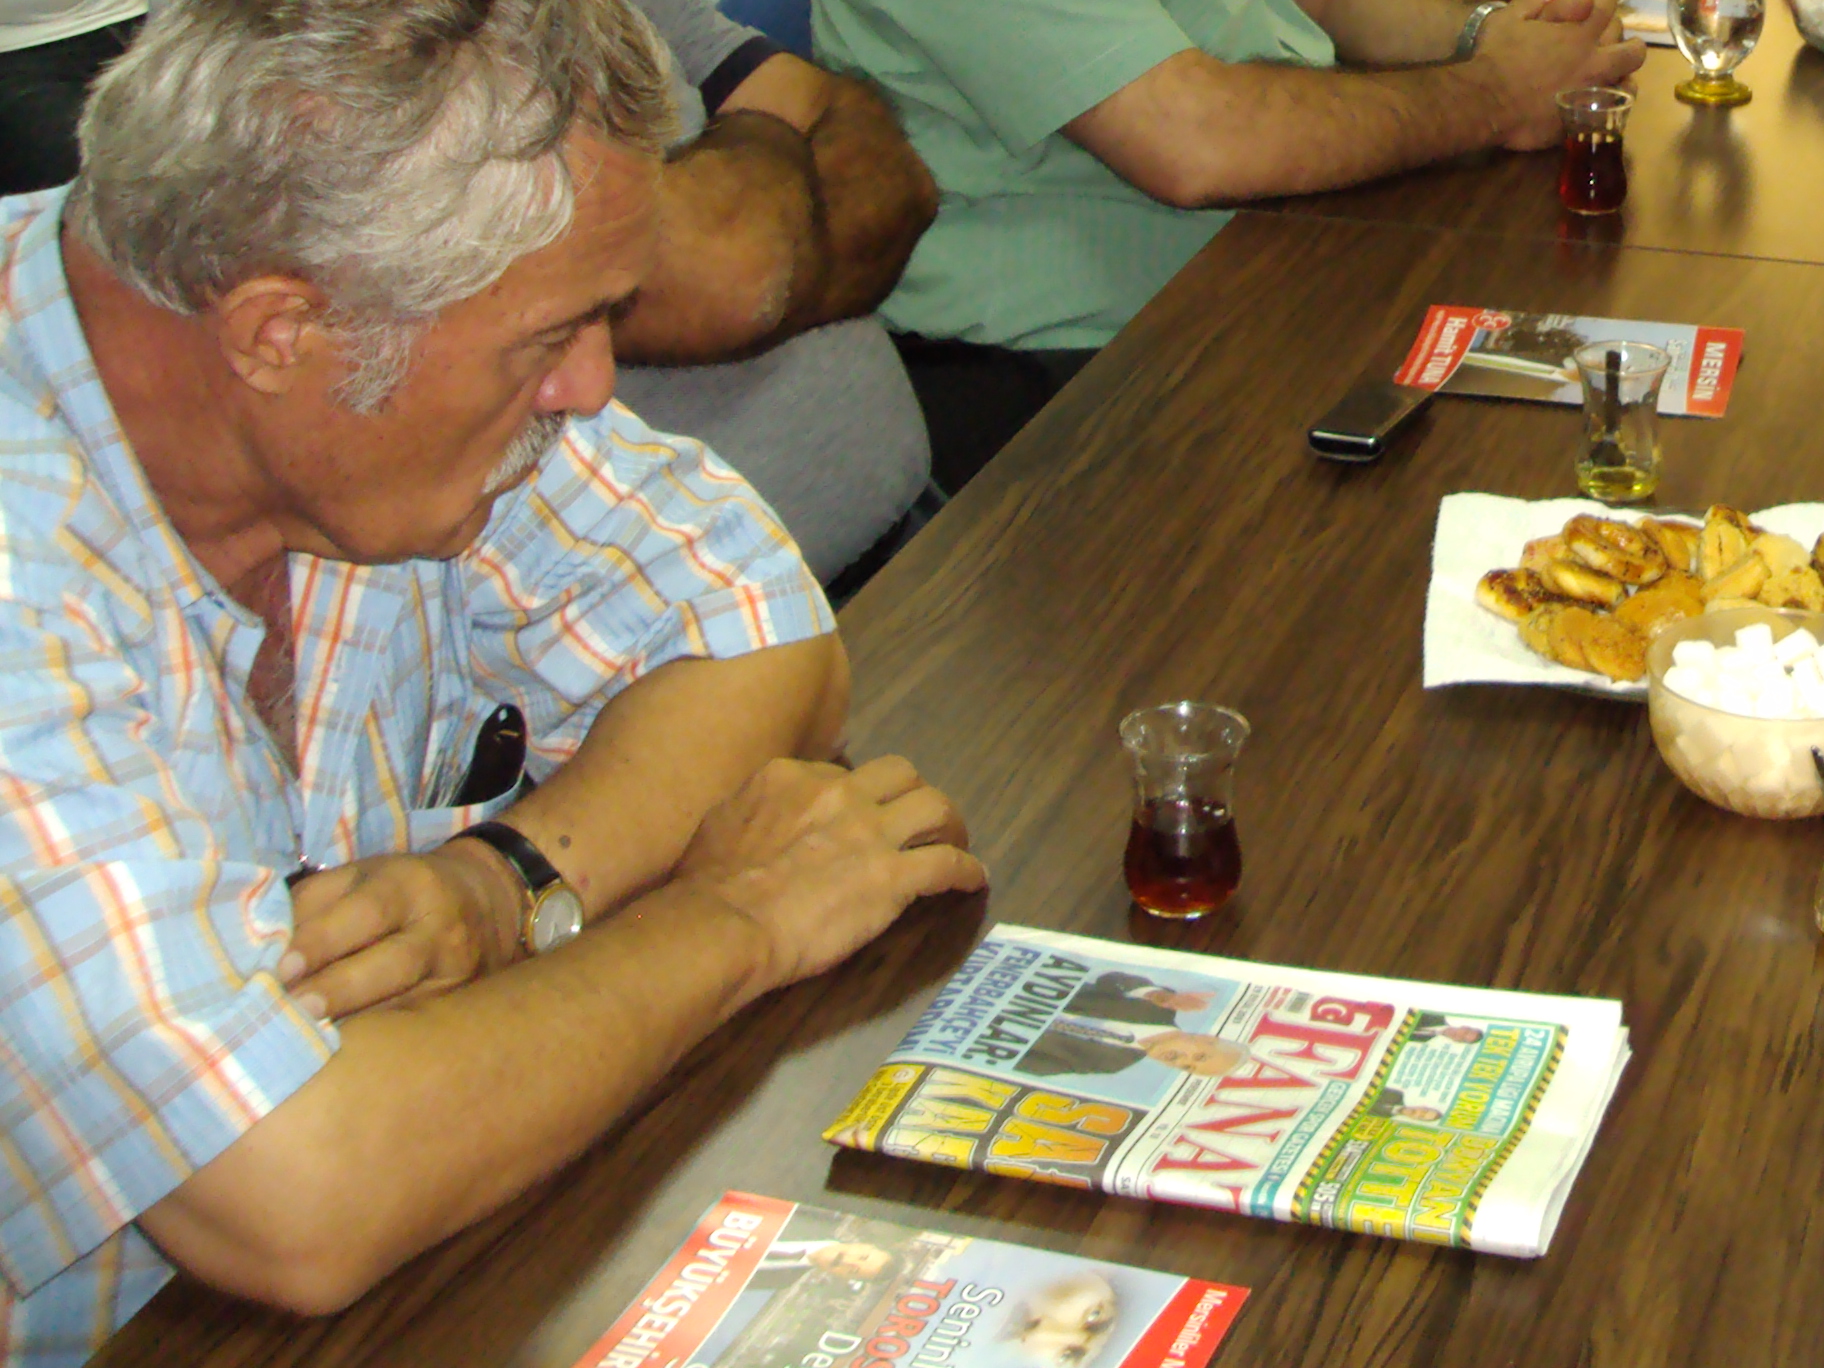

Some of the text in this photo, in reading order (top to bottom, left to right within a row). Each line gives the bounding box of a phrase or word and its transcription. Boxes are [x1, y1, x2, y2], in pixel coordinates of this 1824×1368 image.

[1434, 317, 1468, 354] Hamit
[1418, 355, 1453, 384] TUNA
[1692, 342, 1726, 400] MERSİN
[960, 953, 1090, 1065] AYDINLAR:
[1482, 1028, 1521, 1058] TEK
[1524, 1028, 1546, 1047] 24
[1467, 1057, 1509, 1082] TEK
[984, 1090, 1133, 1189] SA
[909, 1283, 1005, 1368] Senin
[1169, 1288, 1228, 1358] Mersinliler
